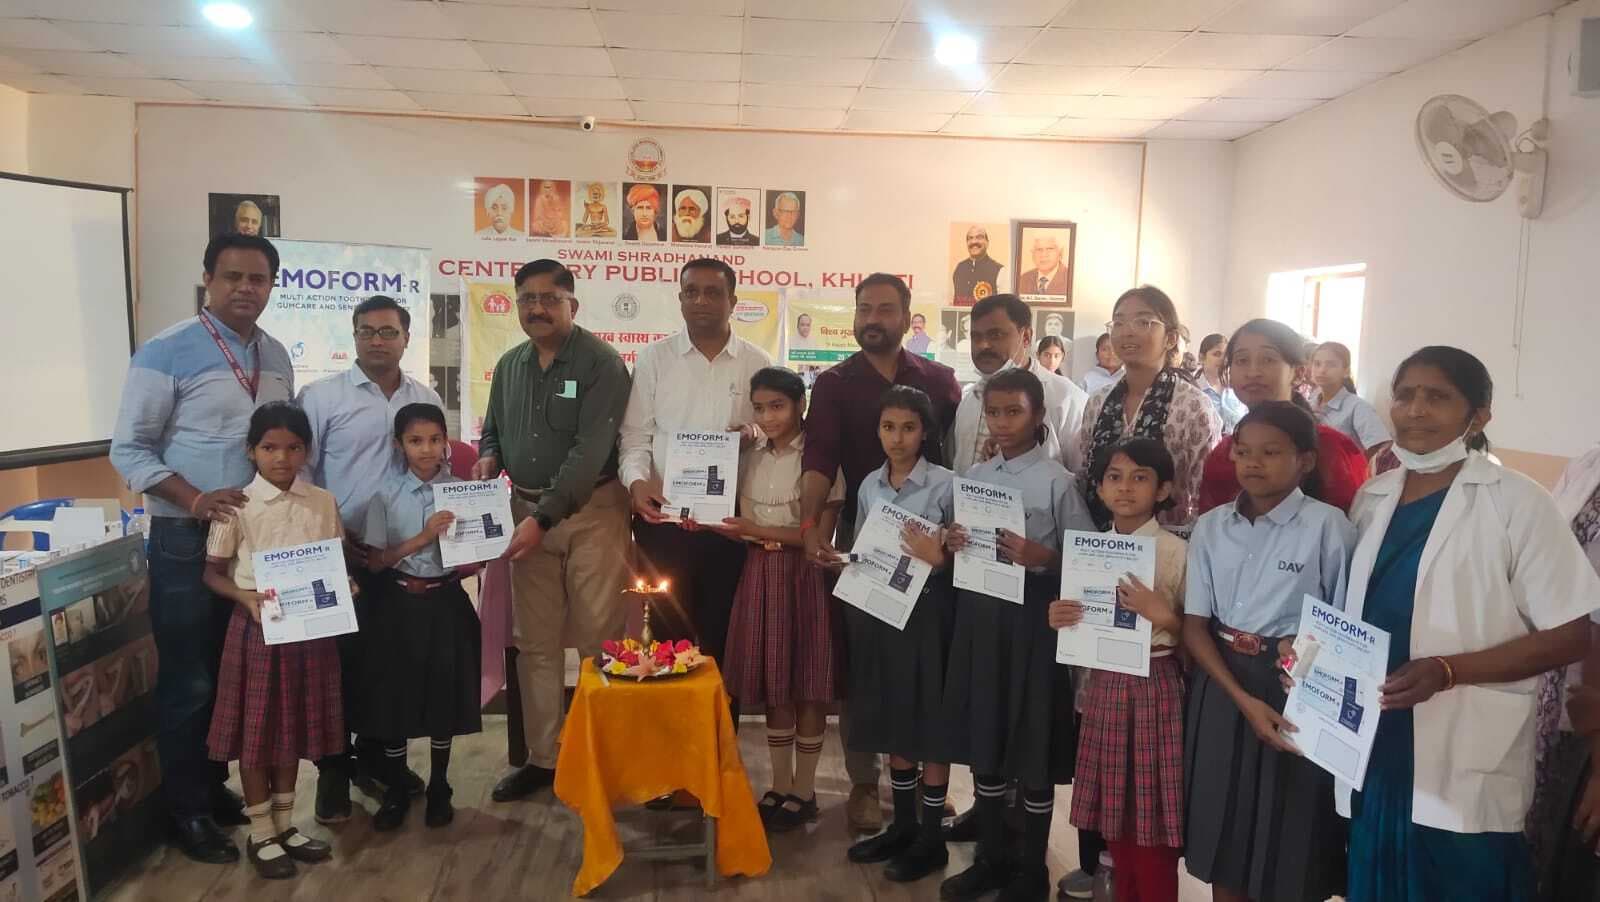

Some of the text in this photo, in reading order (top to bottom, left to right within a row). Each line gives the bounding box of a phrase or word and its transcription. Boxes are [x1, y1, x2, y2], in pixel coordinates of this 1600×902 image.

[558, 249, 612, 262] SWAMI
[438, 259, 598, 282] CENTERY
[606, 264, 680, 283] PUBLI
[737, 269, 813, 288] HOOL,
[307, 294, 336, 302] ACTION
[277, 302, 316, 310] GUMCARE
[1278, 560, 1304, 573] DAV
